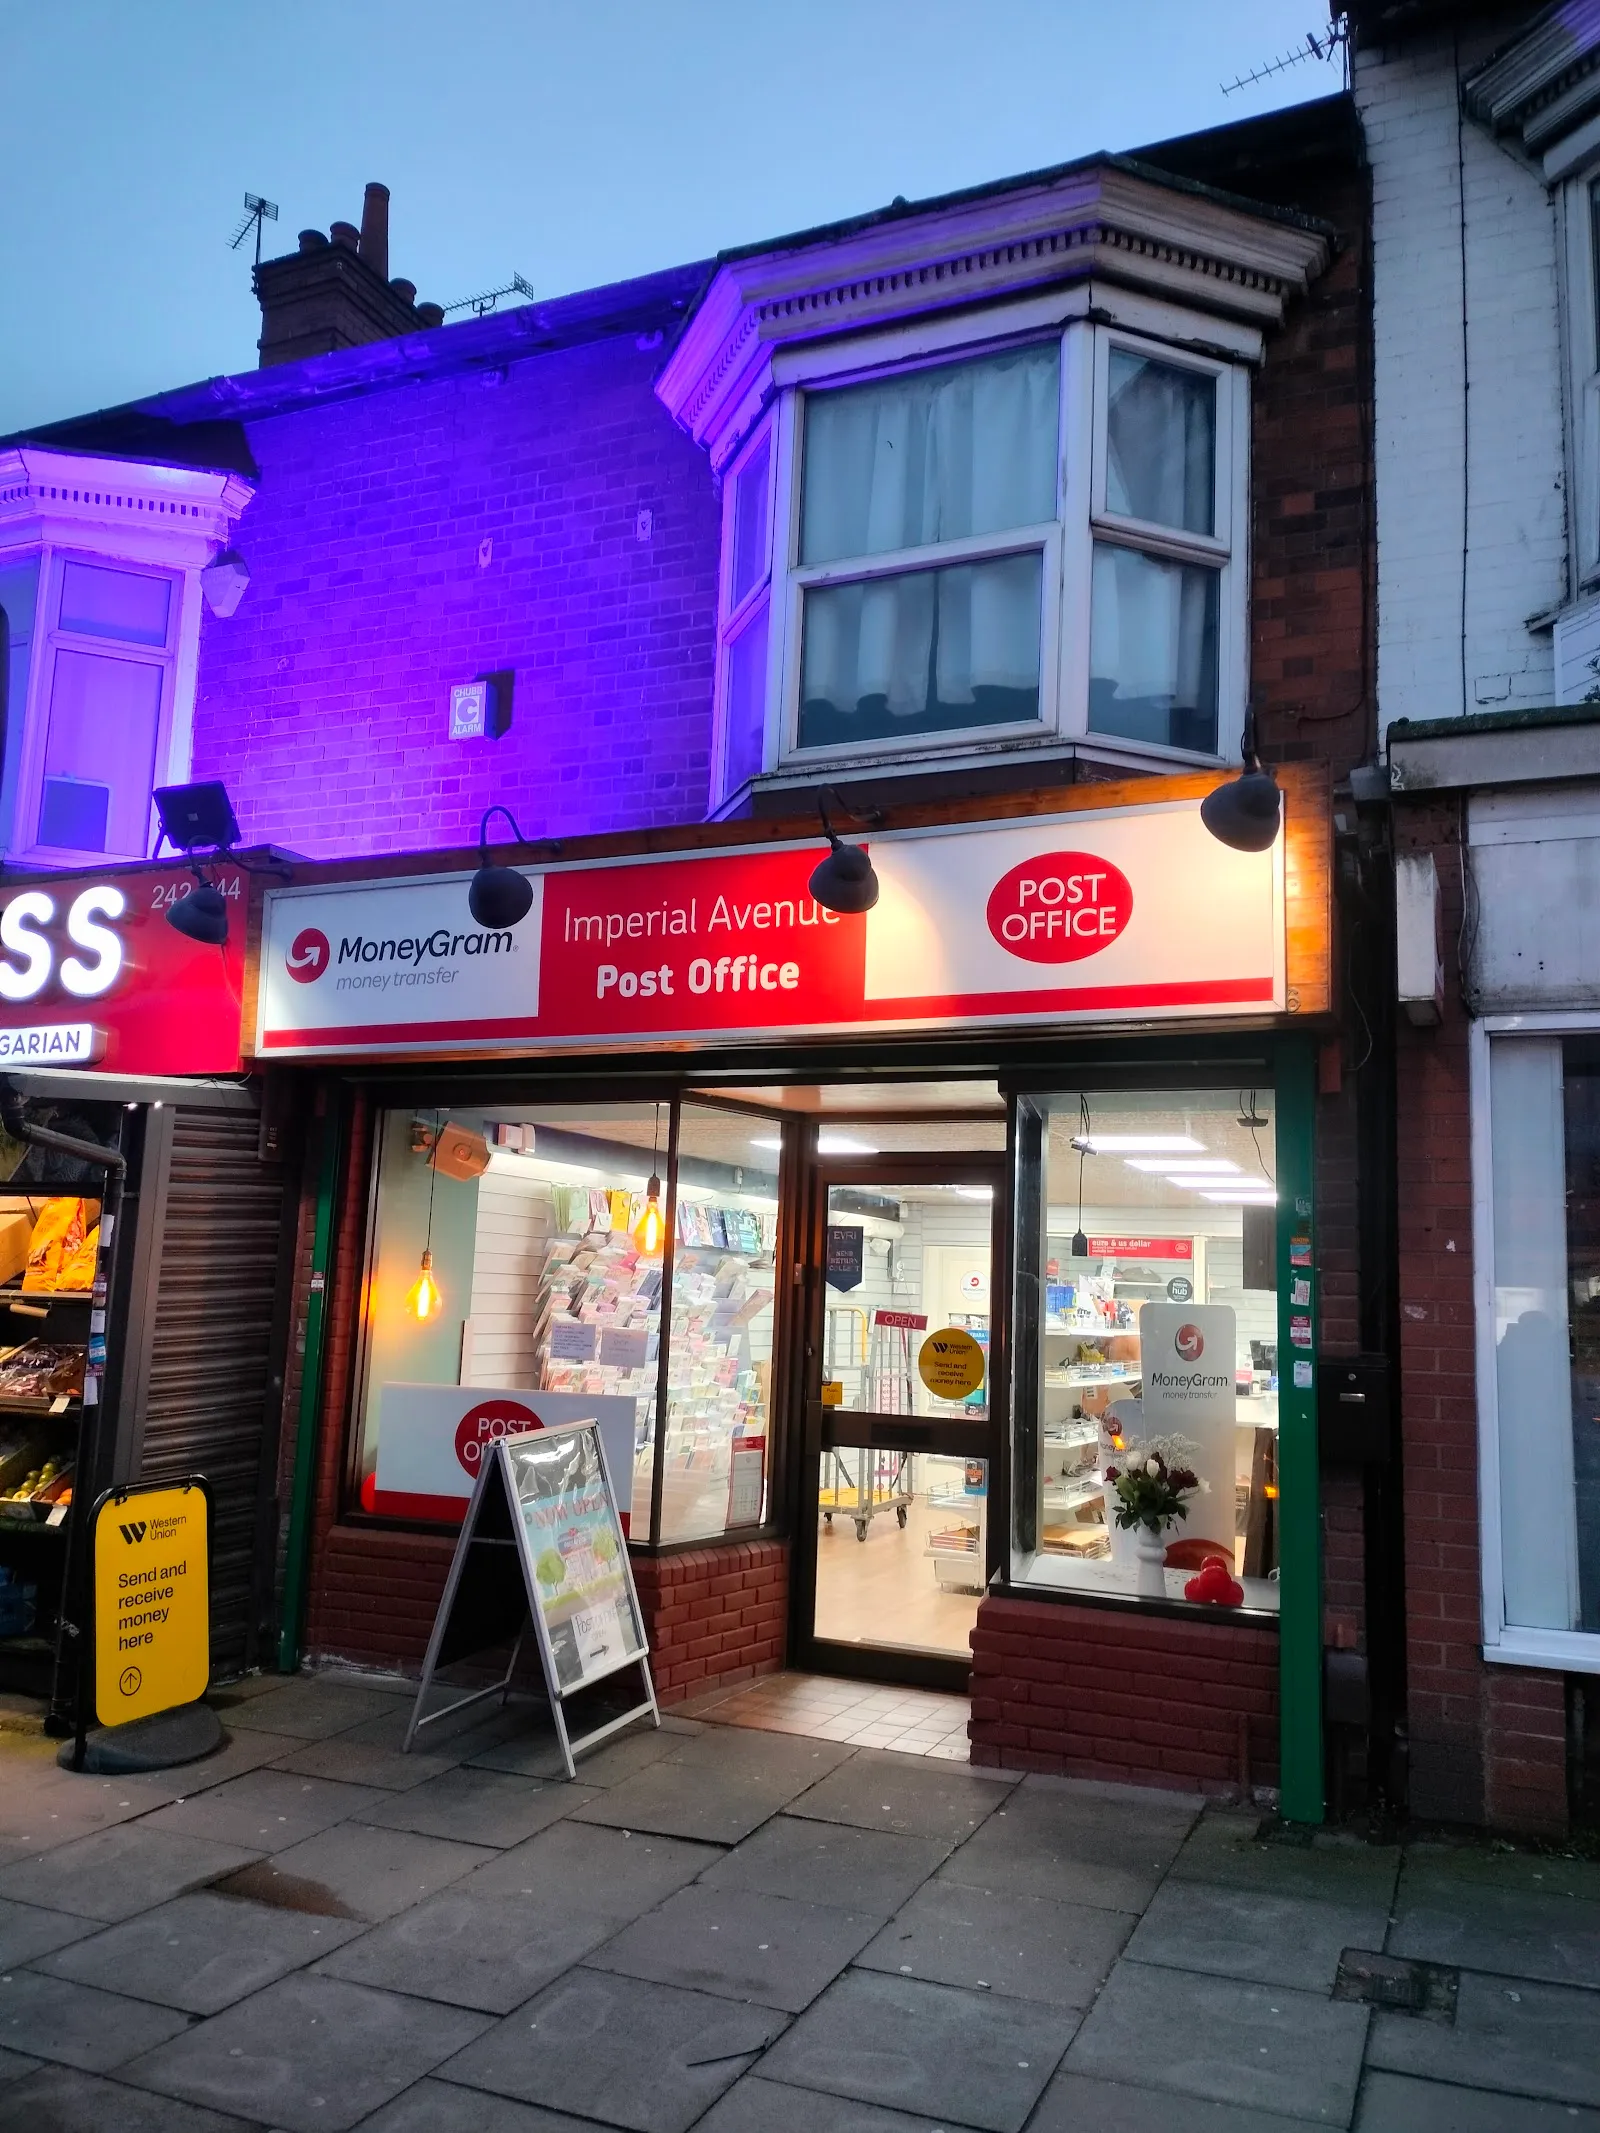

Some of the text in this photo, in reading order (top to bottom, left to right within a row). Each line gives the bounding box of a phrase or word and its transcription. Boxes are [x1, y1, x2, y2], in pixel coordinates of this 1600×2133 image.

[454, 686, 482, 697] CHUBB
[452, 723, 481, 735] ALARM
[1019, 873, 1107, 907] POST
[564, 895, 841, 947] Imperial Avenue
[1002, 906, 1116, 941] OFFICE
[337, 930, 514, 967] MoneyGram
[336, 967, 459, 992] money transfer
[596, 954, 800, 999] Post Office
[833, 1231, 857, 1240] EVRI
[1129, 1240, 1152, 1248] dollar
[829, 1264, 860, 1272] CLLET
[1172, 1286, 1188, 1296] hub
[884, 1314, 917, 1328] OPEN
[930, 1378, 954, 1386] money
[1151, 1372, 1228, 1390] MoneyGram
[1162, 1391, 1187, 1401] money
[149, 1515, 187, 1530] Western
[149, 1528, 177, 1541] Union
[118, 1560, 187, 1588] Send and
[118, 1586, 174, 1609] receive
[118, 1607, 170, 1631] money
[119, 1632, 154, 1651] here
